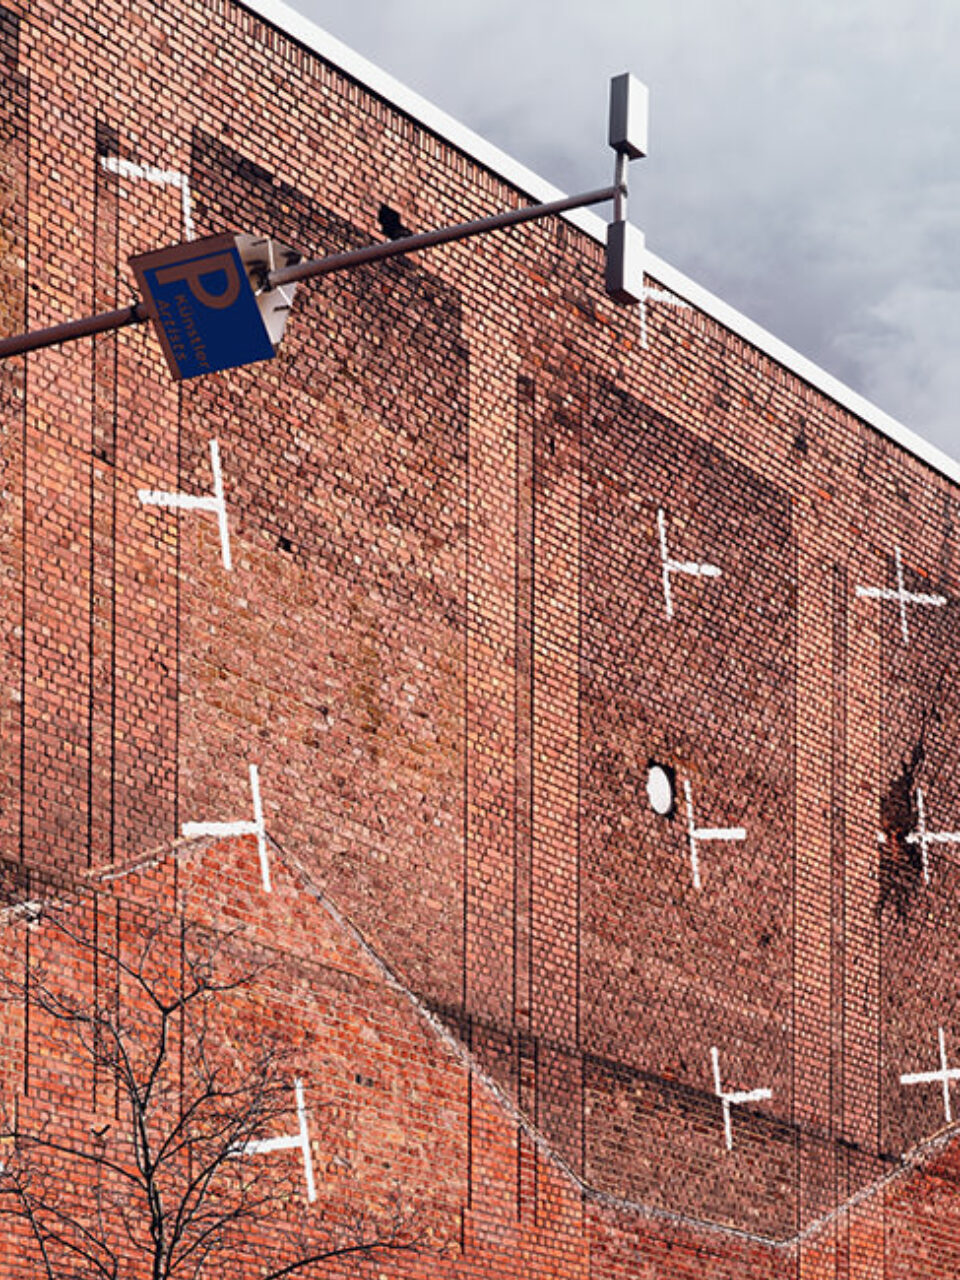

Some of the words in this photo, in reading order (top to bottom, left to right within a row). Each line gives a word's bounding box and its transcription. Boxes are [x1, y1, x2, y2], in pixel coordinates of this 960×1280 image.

[154, 251, 240, 310] P
[157, 300, 187, 362] Artists
[174, 293, 211, 370] Künstler
